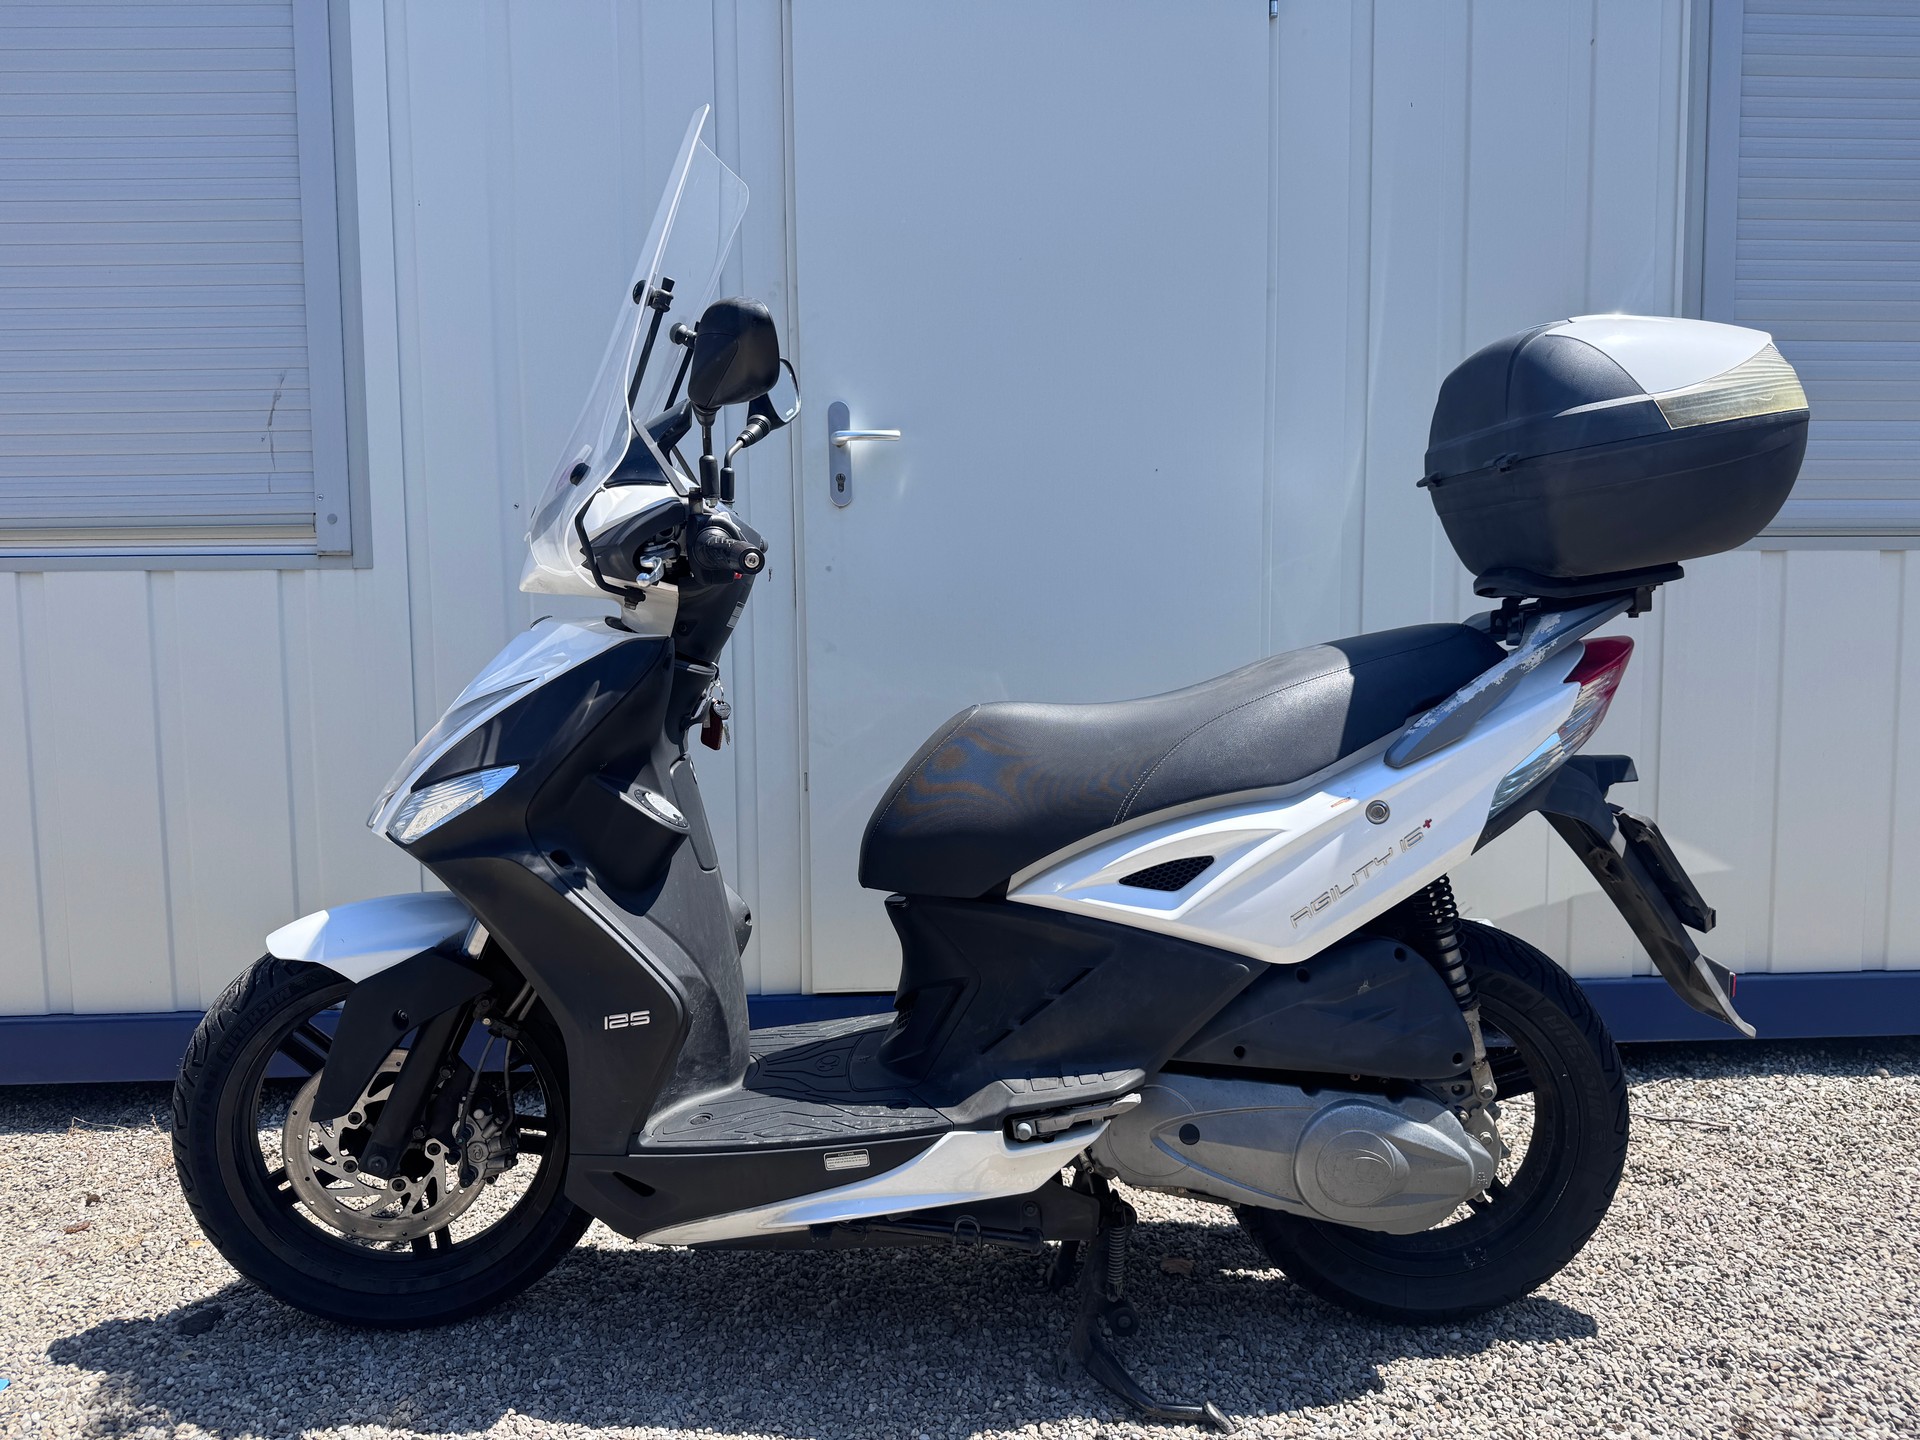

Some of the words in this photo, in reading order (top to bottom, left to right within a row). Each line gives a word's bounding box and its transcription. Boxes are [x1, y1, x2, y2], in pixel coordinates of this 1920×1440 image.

[1289, 846, 1394, 929] AGILITY
[218, 987, 293, 1063] MICHELIN
[603, 1009, 651, 1031] 125
